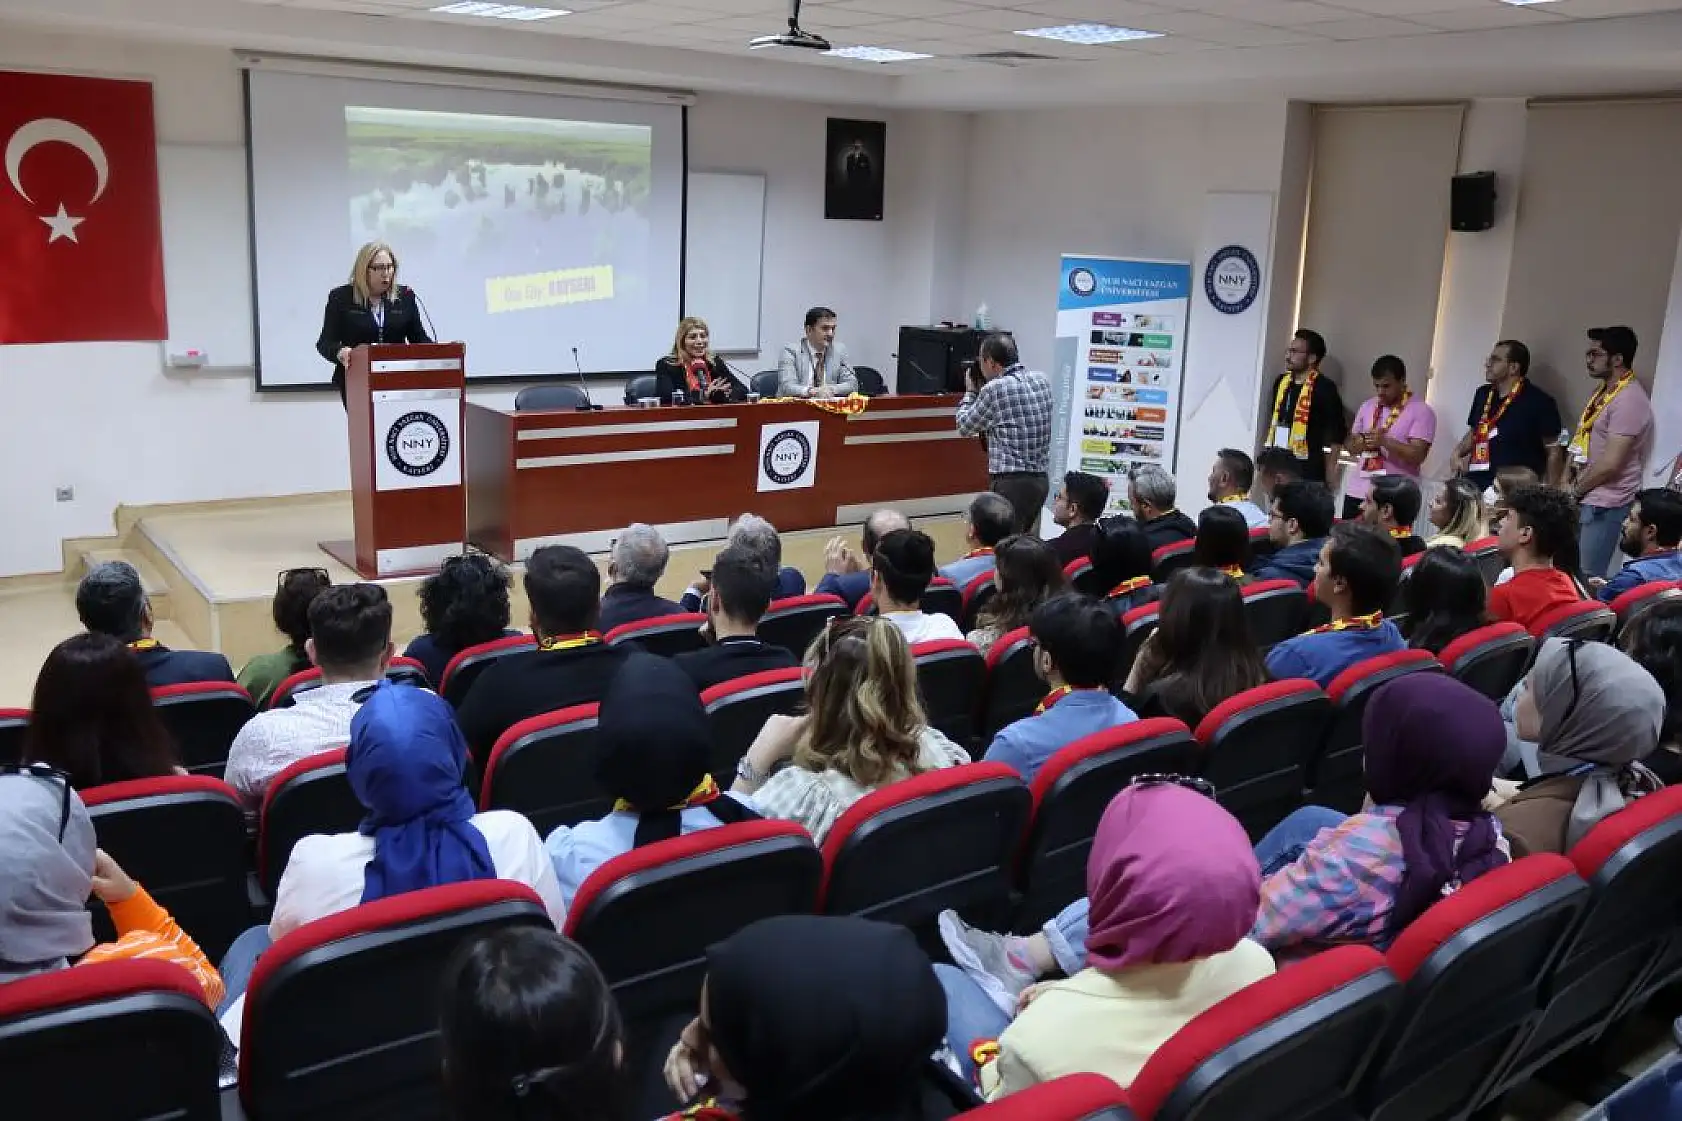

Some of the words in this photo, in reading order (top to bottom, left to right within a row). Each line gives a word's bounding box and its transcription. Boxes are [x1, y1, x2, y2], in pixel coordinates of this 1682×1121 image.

[1219, 274, 1246, 287] NNY
[402, 437, 434, 450] NNY
[776, 452, 799, 462] NNY
